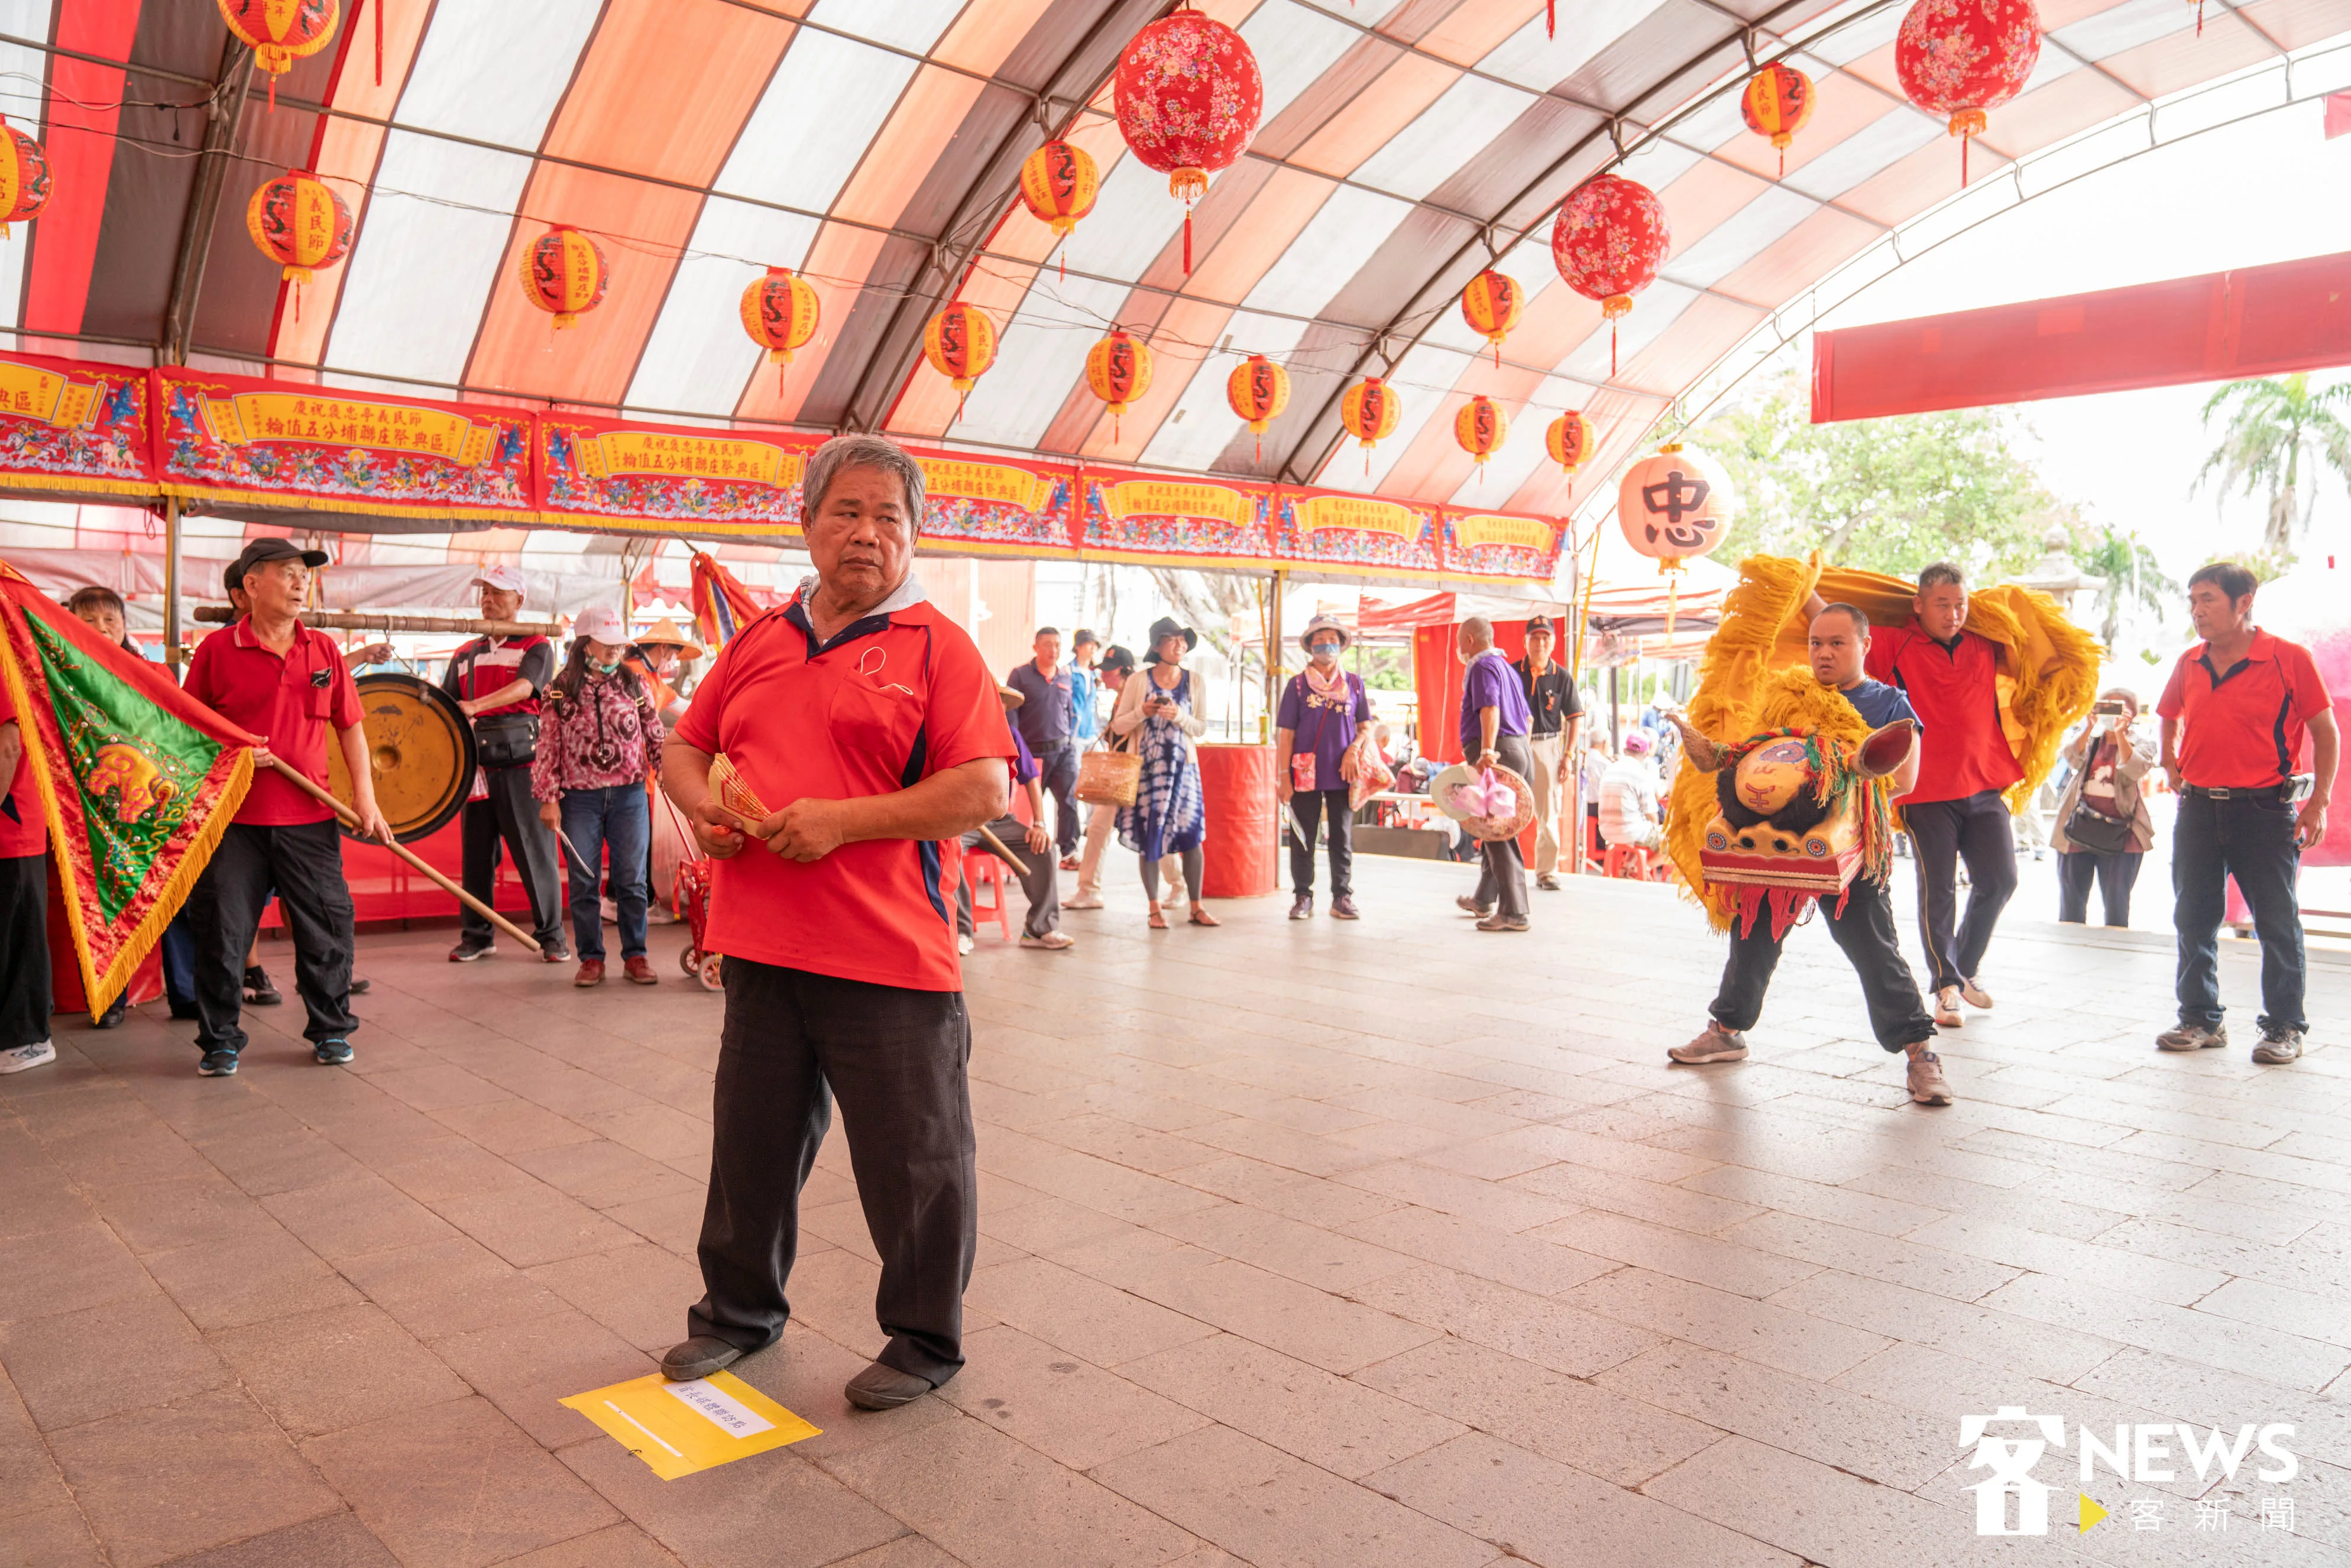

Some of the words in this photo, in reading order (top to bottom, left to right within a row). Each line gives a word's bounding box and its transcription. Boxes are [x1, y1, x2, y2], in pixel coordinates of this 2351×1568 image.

[308, 197, 325, 250] 義民節
[293, 399, 422, 427] 慶祝褒忠亭義民節
[265, 416, 443, 451] 輪值五分埔聯庄祭典區
[642, 436, 744, 457] 慶祝褒忠亭義民節
[623, 452, 760, 479] 輪值五分埔聯庄祭典區
[926, 478, 1018, 500] 五分埔聯庄祭典區
[1643, 471, 1715, 547] 忠
